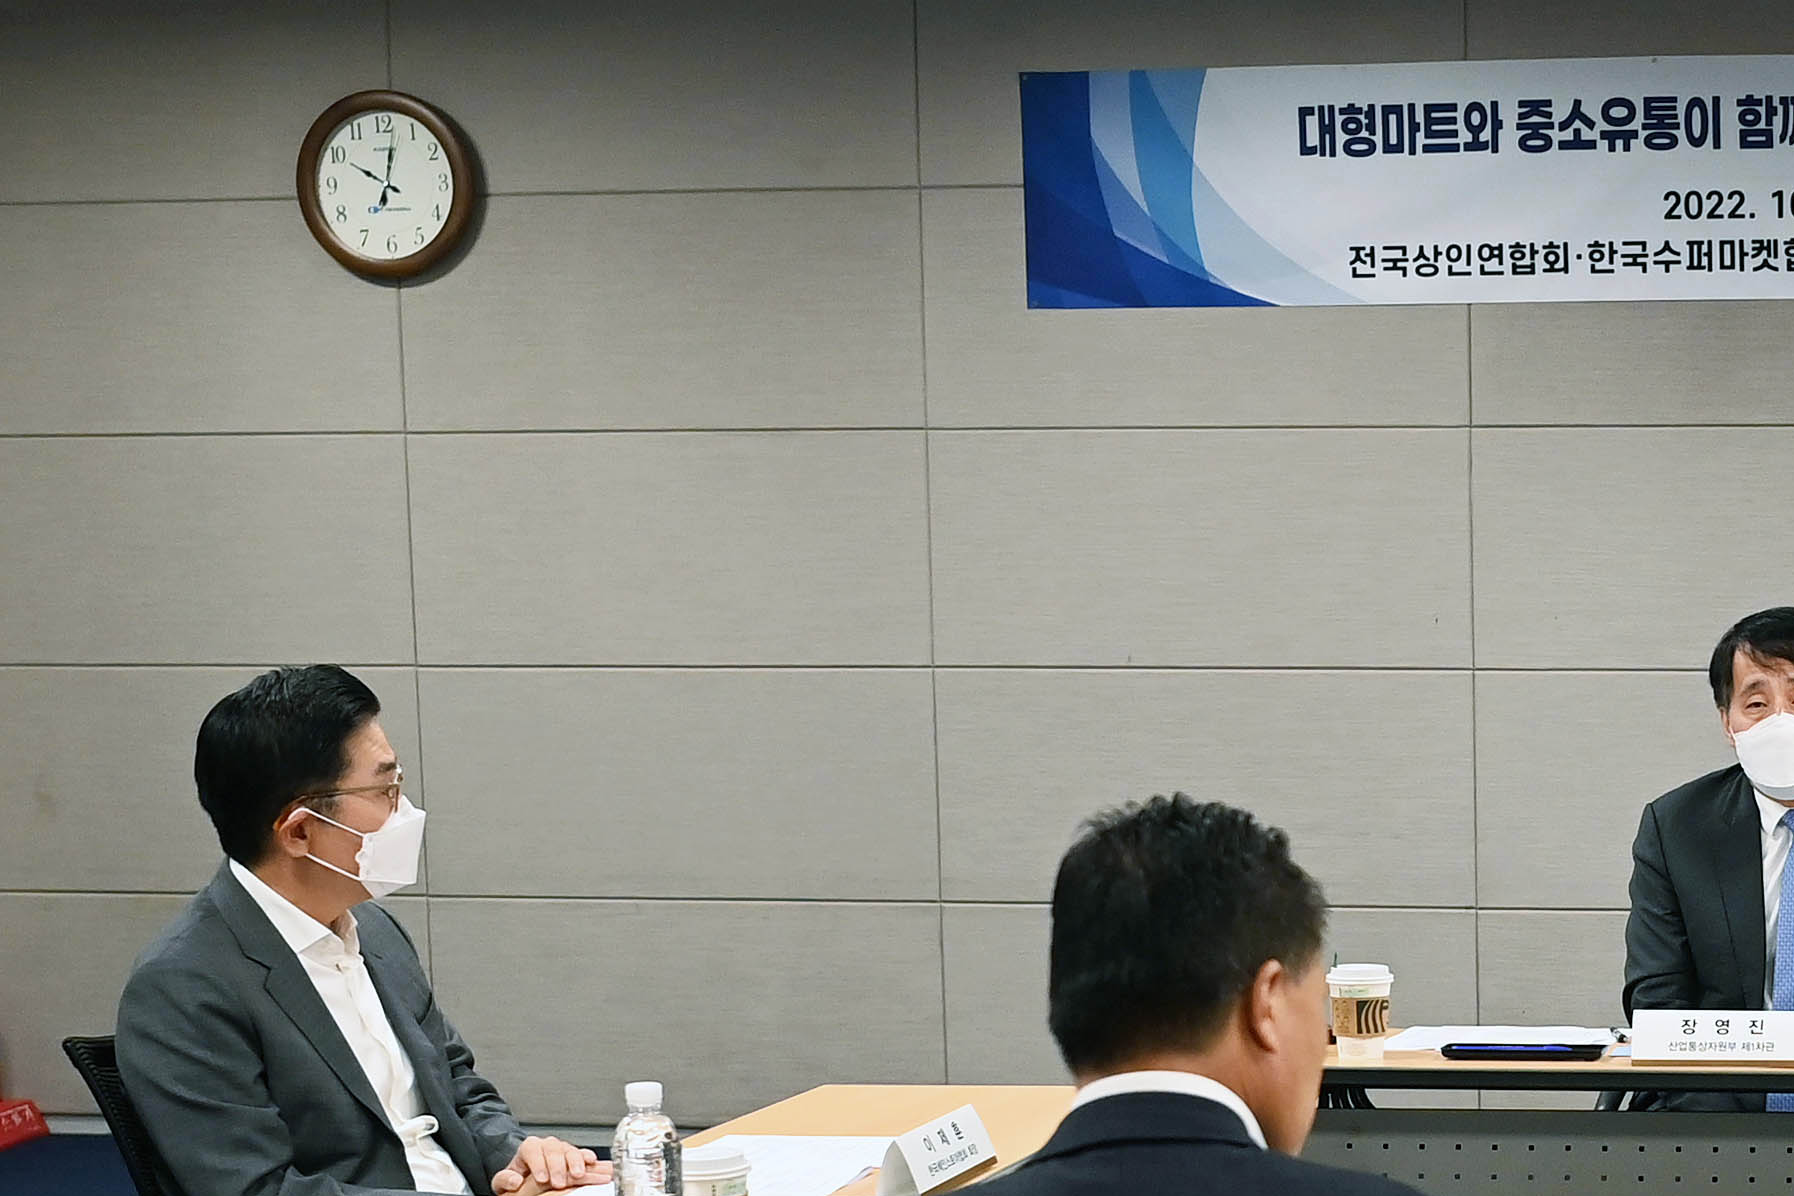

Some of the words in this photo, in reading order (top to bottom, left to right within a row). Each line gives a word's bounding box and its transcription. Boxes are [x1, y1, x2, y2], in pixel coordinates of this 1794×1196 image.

[350, 122, 362, 140] 11
[374, 114, 392, 133] 12
[409, 122, 416, 141] 1
[1297, 101, 1504, 158] 대형마트와
[1515, 96, 1722, 154] 중소유통이
[330, 145, 346, 164] 10
[428, 142, 439, 161] 2
[326, 175, 338, 195] 9
[438, 173, 449, 192] 3
[431, 203, 442, 222] 4
[1663, 189, 1756, 220] 2022.
[336, 205, 347, 224] 8
[359, 229, 369, 247] 7
[386, 234, 398, 254] 6
[414, 226, 425, 245] 5
